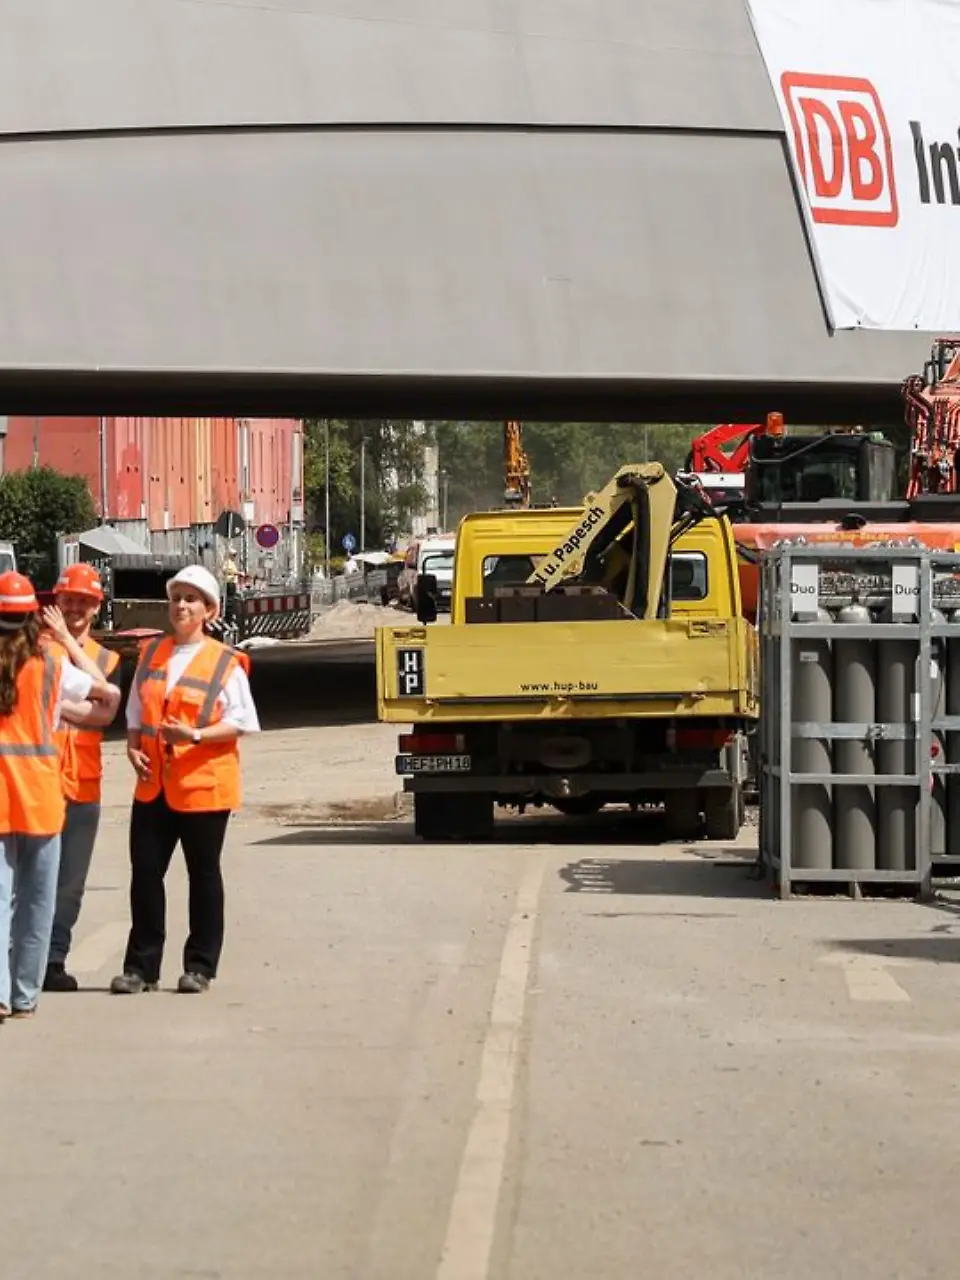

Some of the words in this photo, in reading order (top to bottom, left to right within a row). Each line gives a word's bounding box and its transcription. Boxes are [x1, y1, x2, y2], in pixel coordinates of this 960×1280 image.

[797, 96, 884, 201] DB
[908, 120, 960, 206] In
[553, 507, 605, 562] Papesch
[790, 582, 815, 594] Duo
[895, 584, 920, 596] Duo
[520, 680, 598, 693] www.hup-bau
